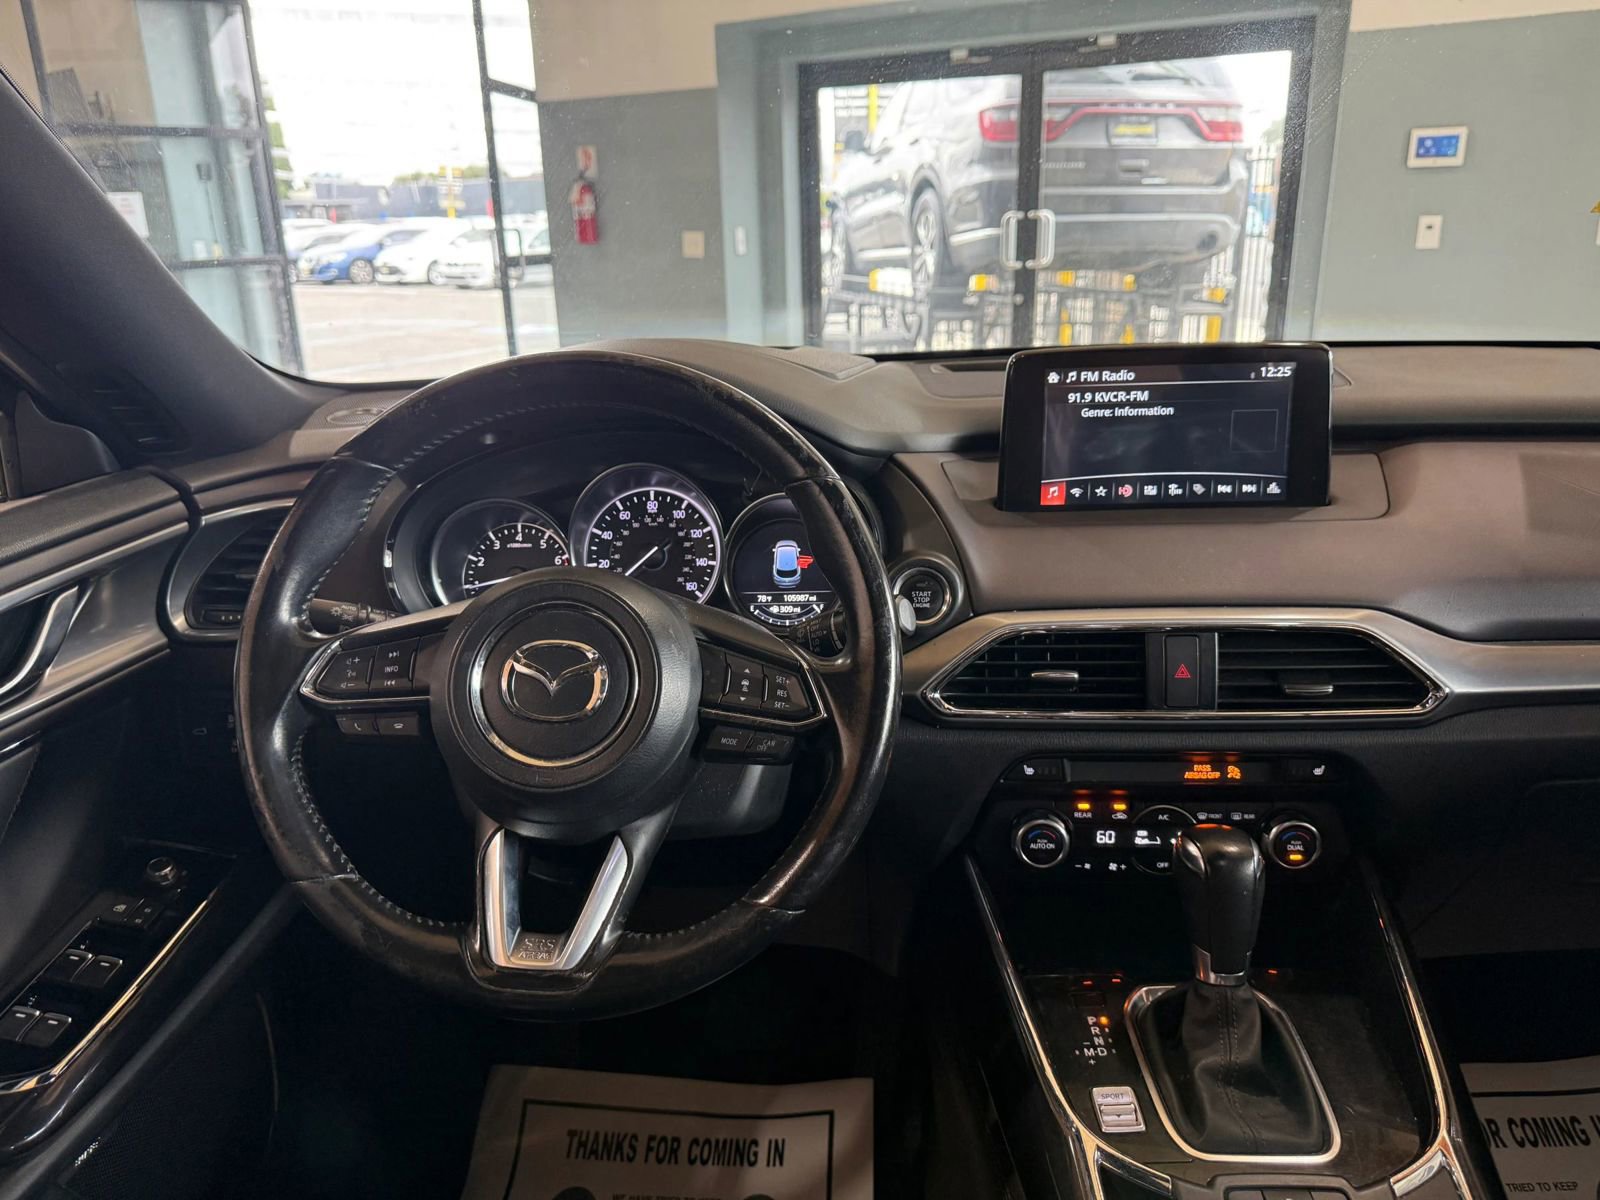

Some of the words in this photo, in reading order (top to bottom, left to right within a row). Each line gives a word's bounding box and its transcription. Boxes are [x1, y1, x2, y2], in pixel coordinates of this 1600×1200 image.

[1080, 371, 1099, 382] FM
[1102, 369, 1135, 382] Radio
[1260, 366, 1292, 377] 12:25
[1067, 391, 1092, 403] 91.9
[1095, 390, 1149, 402] KVCR-FM
[1081, 408, 1113, 417] Genre:
[1114, 405, 1174, 417] Information
[646, 501, 658, 510] 80
[619, 511, 631, 520] 60
[673, 510, 686, 519] 100
[515, 533, 523, 542] 4
[601, 531, 613, 540] 40
[690, 529, 703, 538] 120
[493, 540, 500, 550] 3
[540, 540, 547, 549] 5
[477, 556, 485, 567] 2
[554, 555, 562, 565] 6
[599, 560, 610, 569] 20
[695, 558, 708, 567] 140
[685, 582, 698, 591] 160
[783, 594, 809, 602] 105987
[341, 603, 357, 611] AUTO
[780, 605, 793, 613] 309
[776, 689, 788, 698] RES
[720, 737, 738, 746] MODE
[1096, 830, 1116, 844] 60
[1087, 1016, 1096, 1025] P
[1091, 1026, 1100, 1035] R
[1094, 1036, 1104, 1046] N
[1101, 1092, 1125, 1101] SPORT
[1507, 1115, 1591, 1149] COMING
[566, 1129, 638, 1163] THANKS
[644, 1134, 681, 1166] FOR
[688, 1138, 760, 1168] COMING
[766, 1138, 786, 1168] IN
[1506, 1182, 1536, 1192] TRIED
[1536, 1181, 1551, 1191] TO
[1554, 1181, 1579, 1191] KEEP
